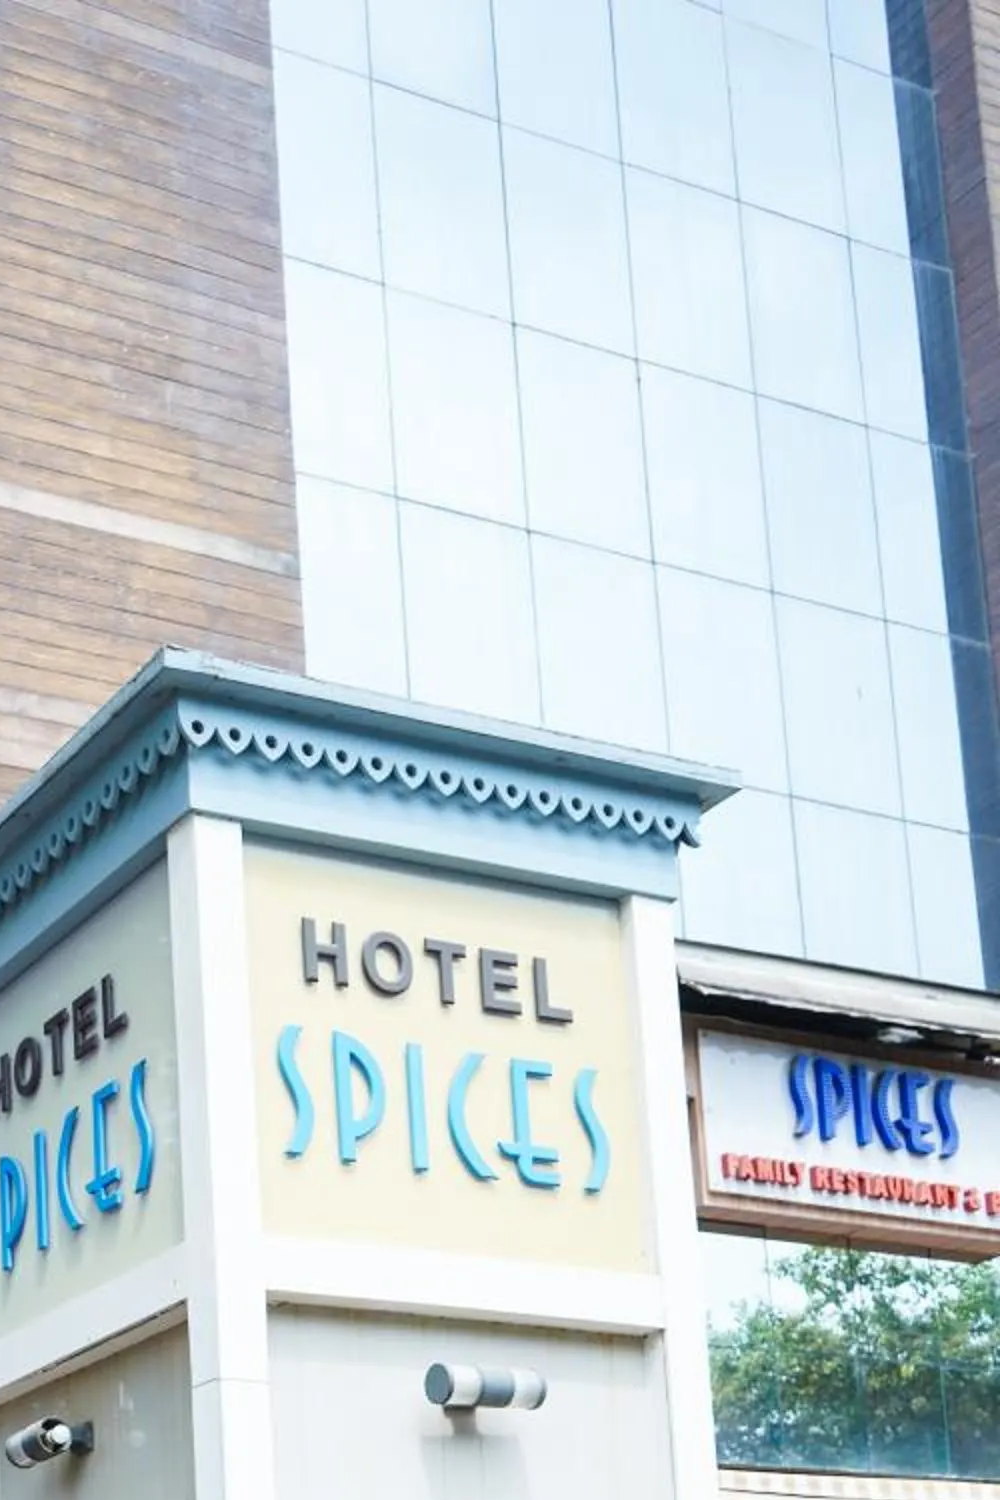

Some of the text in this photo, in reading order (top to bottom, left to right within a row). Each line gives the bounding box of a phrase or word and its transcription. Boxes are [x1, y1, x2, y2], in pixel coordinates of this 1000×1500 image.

[301, 916, 573, 1025] HOTEL
[277, 1023, 611, 1194] SPICES
[789, 1054, 959, 1159] SPICES
[721, 1152, 804, 1186] FAMILY
[810, 1165, 960, 1211] RESTAURANT
